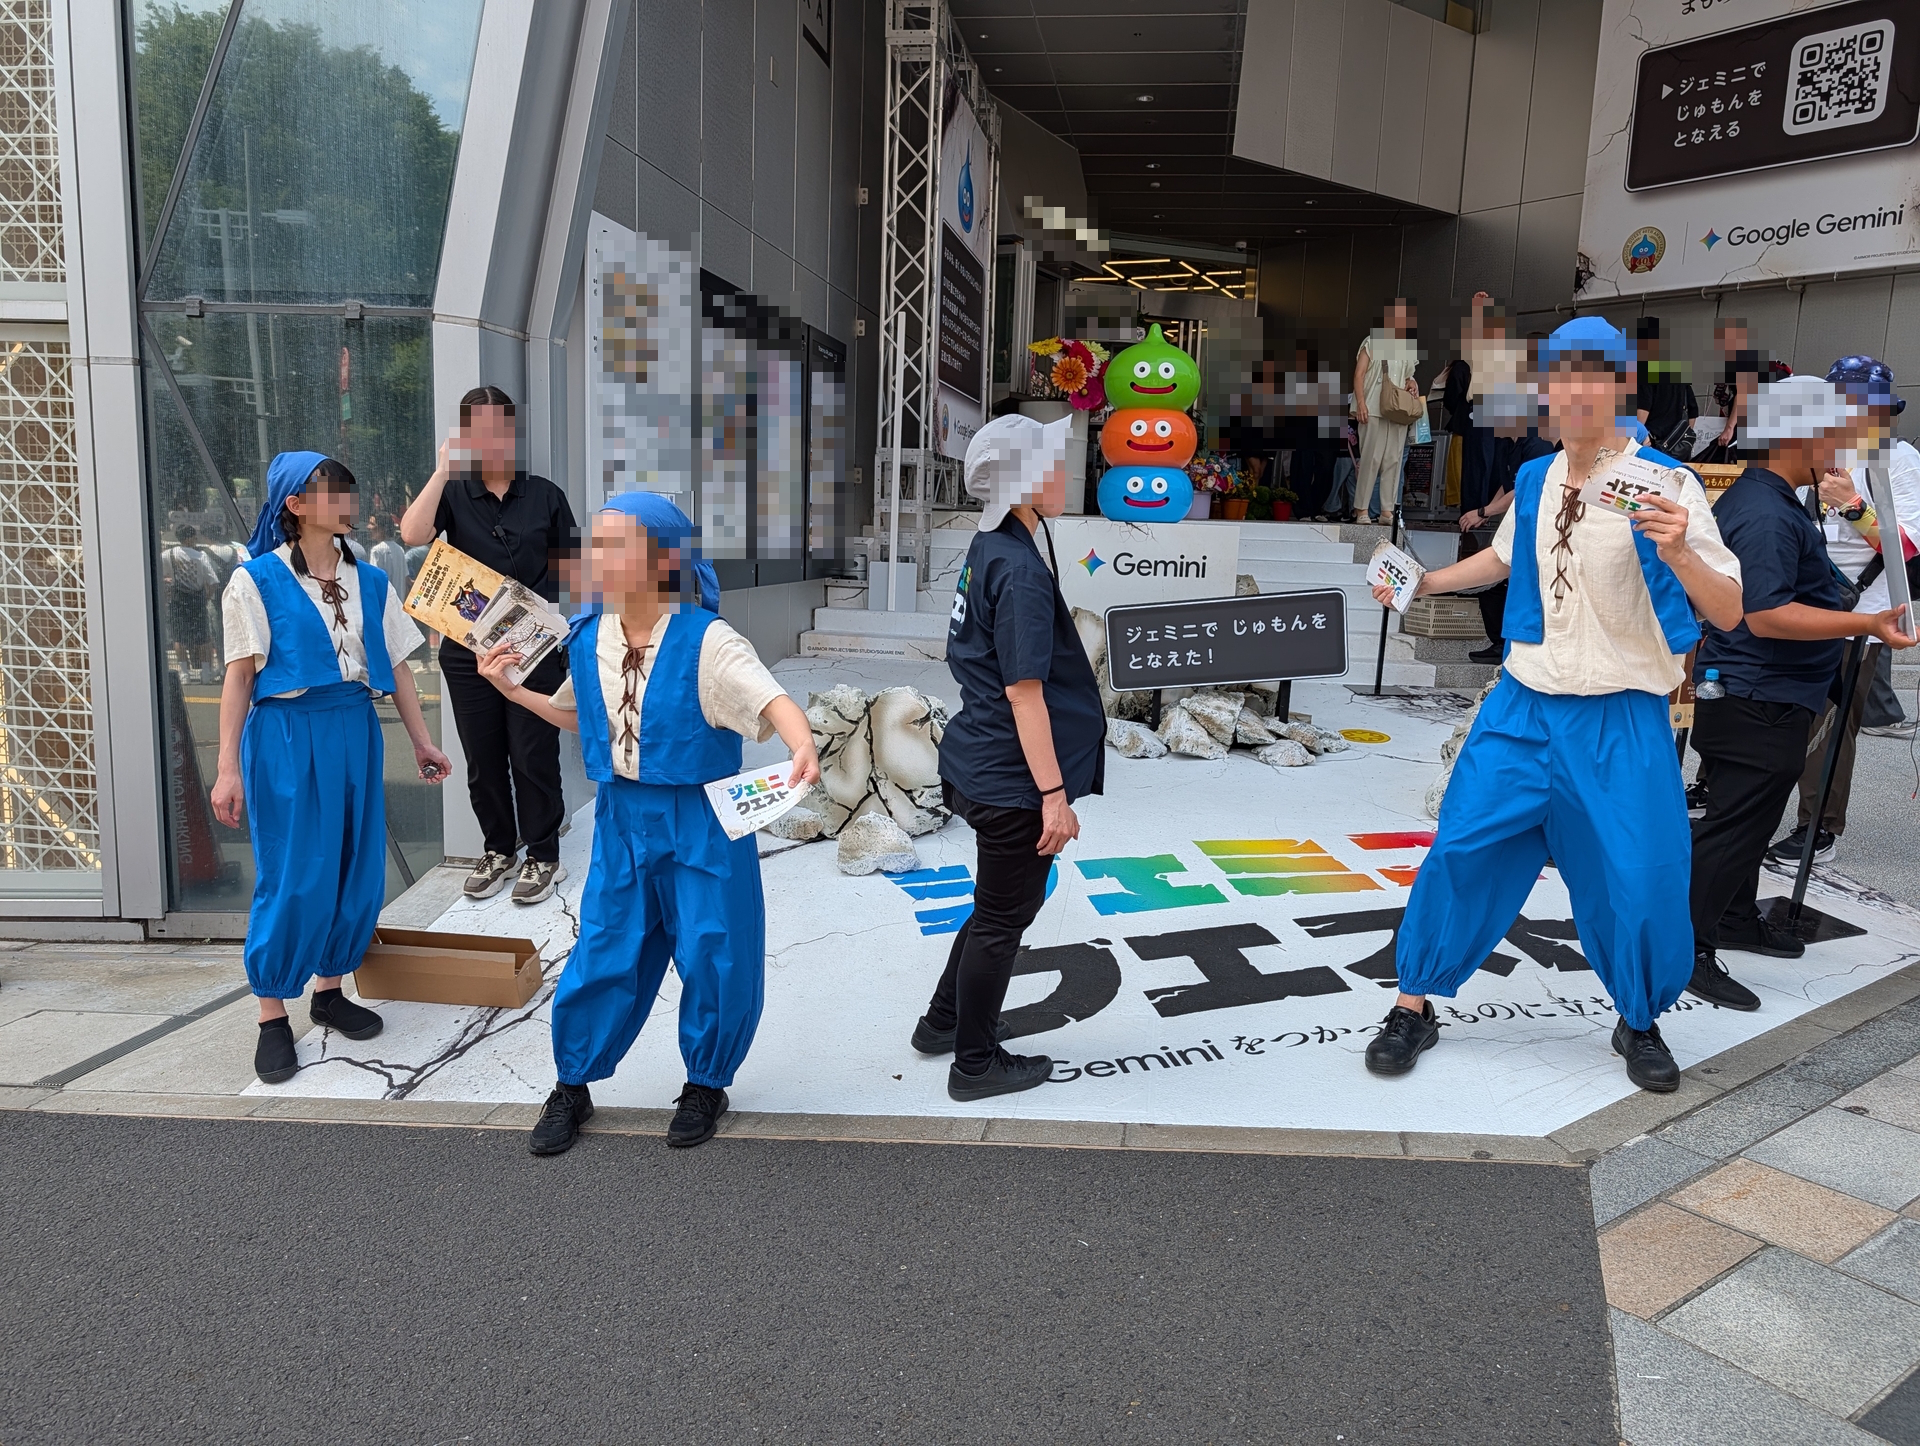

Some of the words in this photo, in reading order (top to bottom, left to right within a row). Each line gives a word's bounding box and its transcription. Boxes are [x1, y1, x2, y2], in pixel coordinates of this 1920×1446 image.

[1679, 61, 1767, 96] ジェミニで
[1675, 89, 1763, 122] じゅもんを
[1673, 120, 1740, 148] となえる
[1727, 219, 1810, 247] Google
[1816, 203, 1904, 235] Gemini
[1704, 477, 1736, 487] ゅもんの
[1113, 552, 1208, 579] Gemini
[1126, 620, 1218, 645] ジェミニで
[1233, 612, 1327, 636] じゅもんを
[1129, 648, 1213, 670] となえた！
[727, 774, 785, 801] ジェミニ
[737, 790, 789, 816] クエスト
